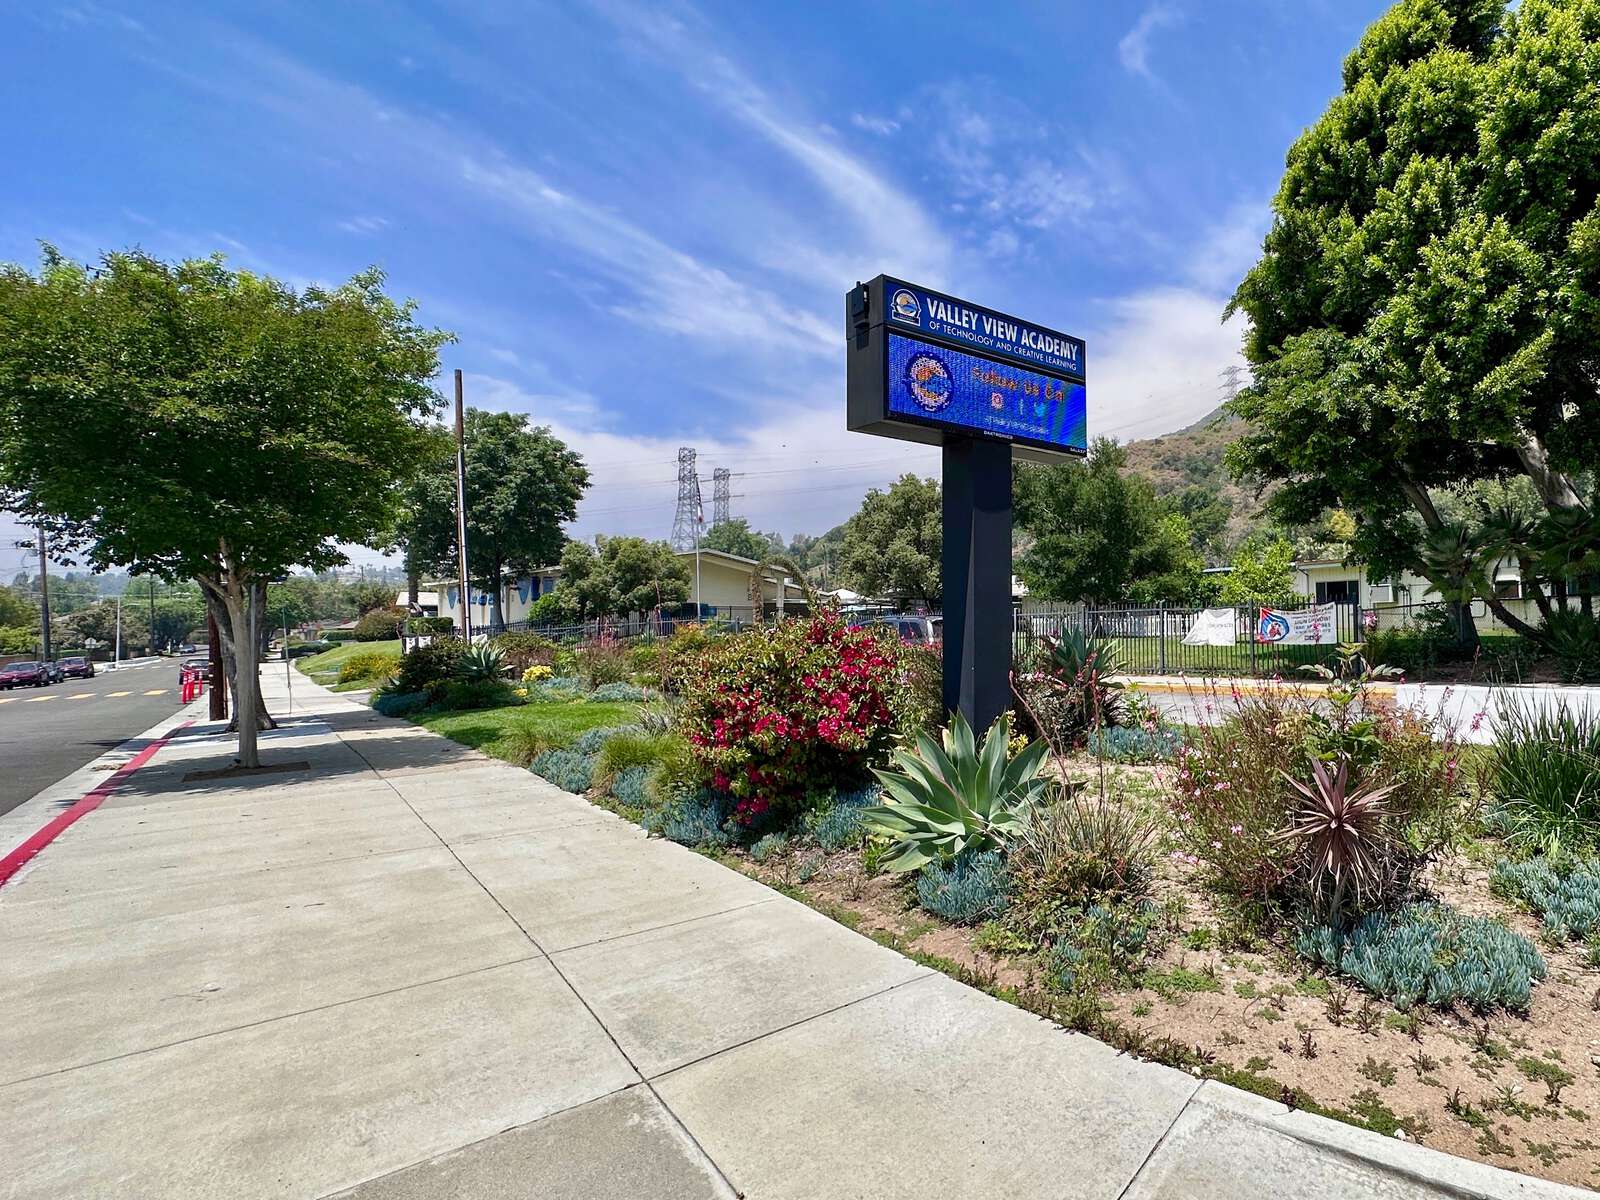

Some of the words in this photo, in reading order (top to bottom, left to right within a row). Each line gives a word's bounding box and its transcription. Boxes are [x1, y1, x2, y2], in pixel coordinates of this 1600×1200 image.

[926, 297, 979, 330] VALLEY
[982, 317, 1018, 342] VIEW
[1021, 329, 1078, 361] ACADEMY
[929, 321, 941, 331] OF
[943, 324, 994, 346] TECHNOLOGY
[995, 340, 1012, 352] AND
[1013, 346, 1044, 361] CREATIVE
[1045, 355, 1077, 371] LEARNING
